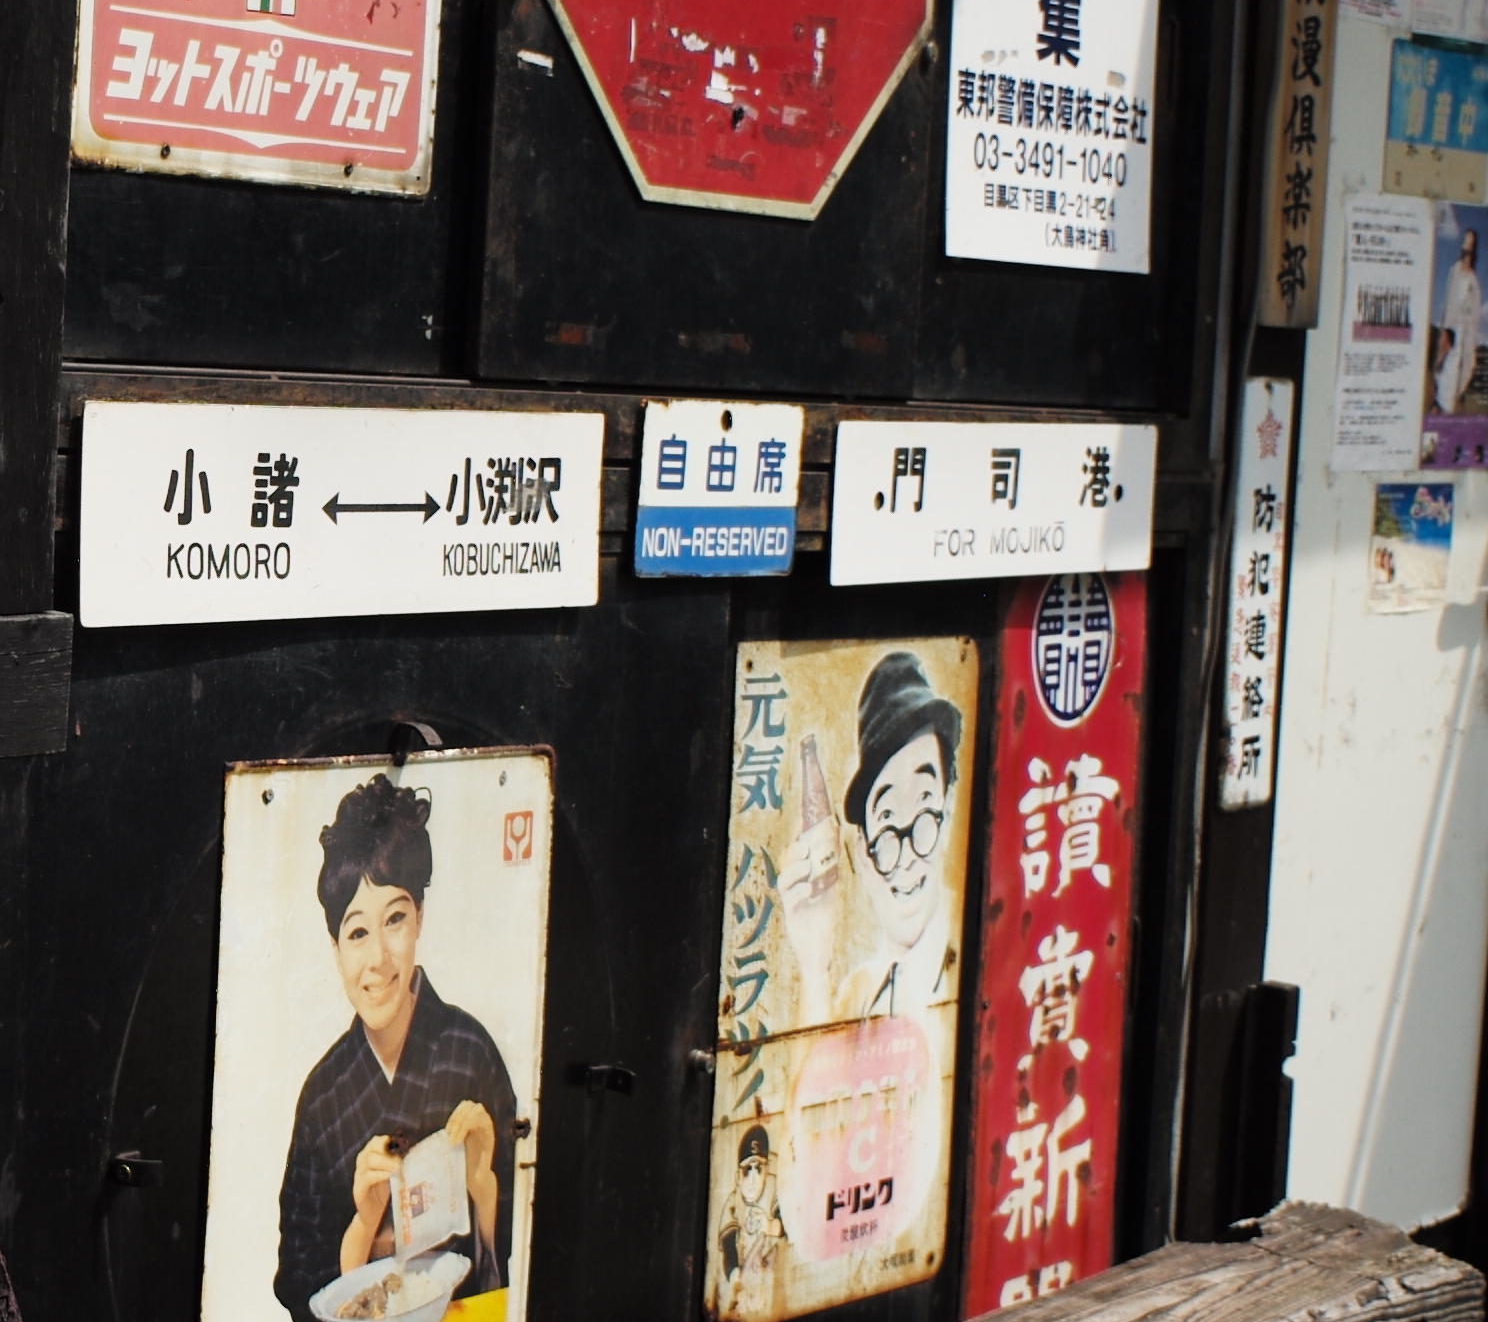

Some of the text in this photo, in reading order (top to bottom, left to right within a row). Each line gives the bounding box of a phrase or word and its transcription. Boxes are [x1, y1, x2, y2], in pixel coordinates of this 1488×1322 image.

[108, 29, 411, 134] ヨットスポーツウェア
[956, 67, 1148, 144] 東邦警備保障株式会社
[973, 131, 1127, 188] 03-3491-1040
[164, 447, 301, 529] 小諸
[655, 438, 789, 498] 自由席
[888, 443, 1112, 513] 門司港
[164, 539, 564, 581] KOMORO KOBUCHIZAWA
[640, 522, 790, 562] NON-RESERVED
[932, 528, 977, 559] FOR
[1237, 485, 1277, 780] 防犯連絡所
[735, 672, 787, 814] 元気
[996, 751, 1121, 1309] 讀賣新
[825, 1175, 895, 1223] ドリンク
